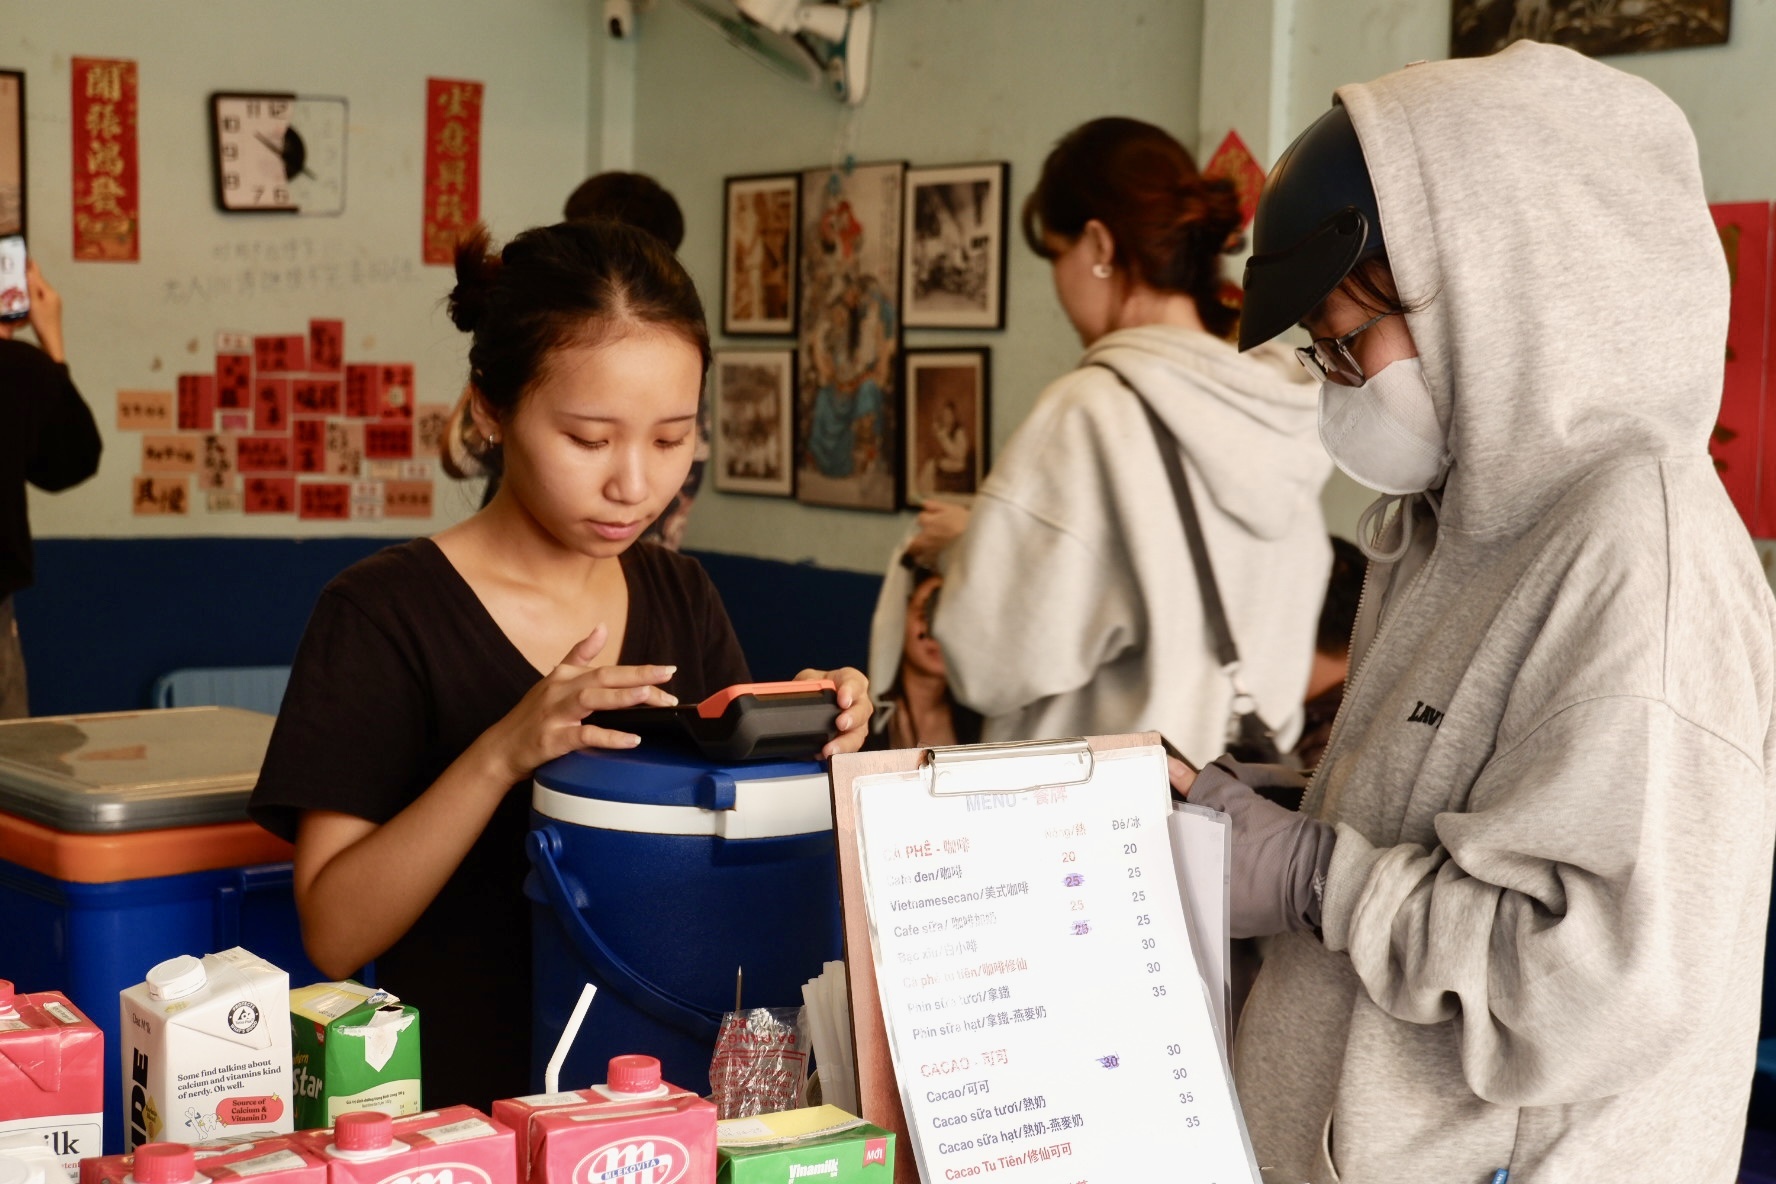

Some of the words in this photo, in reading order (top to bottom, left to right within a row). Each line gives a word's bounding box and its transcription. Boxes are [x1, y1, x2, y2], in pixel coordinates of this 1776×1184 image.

[1407, 700, 1446, 729] LAV
[966, 793, 1017, 812] MENU
[905, 840, 933, 859] PHÊ
[1123, 843, 1138, 855] 20
[1062, 851, 1076, 863] 20
[1127, 867, 1142, 878] 25
[1132, 890, 1146, 902] 25
[1070, 899, 1085, 911] 25
[1136, 914, 1151, 926] 25
[893, 924, 920, 938] Cafe
[1141, 937, 1156, 950] 30
[1146, 961, 1161, 974] 30
[1152, 985, 1167, 997] 35
[1166, 1044, 1181, 1056] 30
[177, 1071, 200, 1082] Some
[201, 1067, 217, 1078] find
[218, 1063, 247, 1074] talking
[247, 1059, 272, 1069] about
[920, 1057, 970, 1078] CACAO
[1172, 1067, 1187, 1080] 30
[177, 1080, 209, 1091] calcium
[210, 1075, 225, 1085] and
[225, 1070, 262, 1081] vitamins
[262, 1066, 282, 1076] kind
[178, 1091, 188, 1100] of
[188, 1087, 213, 1097] nerdy.
[213, 1084, 226, 1093] Oh
[226, 1080, 245, 1091] well.
[926, 1080, 990, 1103] Cacao/可可
[232, 1099, 257, 1107] Source
[257, 1098, 266, 1106] of
[1179, 1091, 1194, 1104] 35
[231, 1105, 260, 1114] Calcium
[231, 1113, 260, 1122] Vitamin
[932, 1112, 968, 1129] Cacao
[970, 1107, 993, 1122] sữa
[1185, 1115, 1201, 1128] 35
[938, 1139, 974, 1155] Cacao
[976, 1133, 999, 1148] sữa
[604, 1160, 657, 1180] MLEKOVITA
[789, 1158, 839, 1179] Vinamilk
[945, 1164, 981, 1181] Cacao
